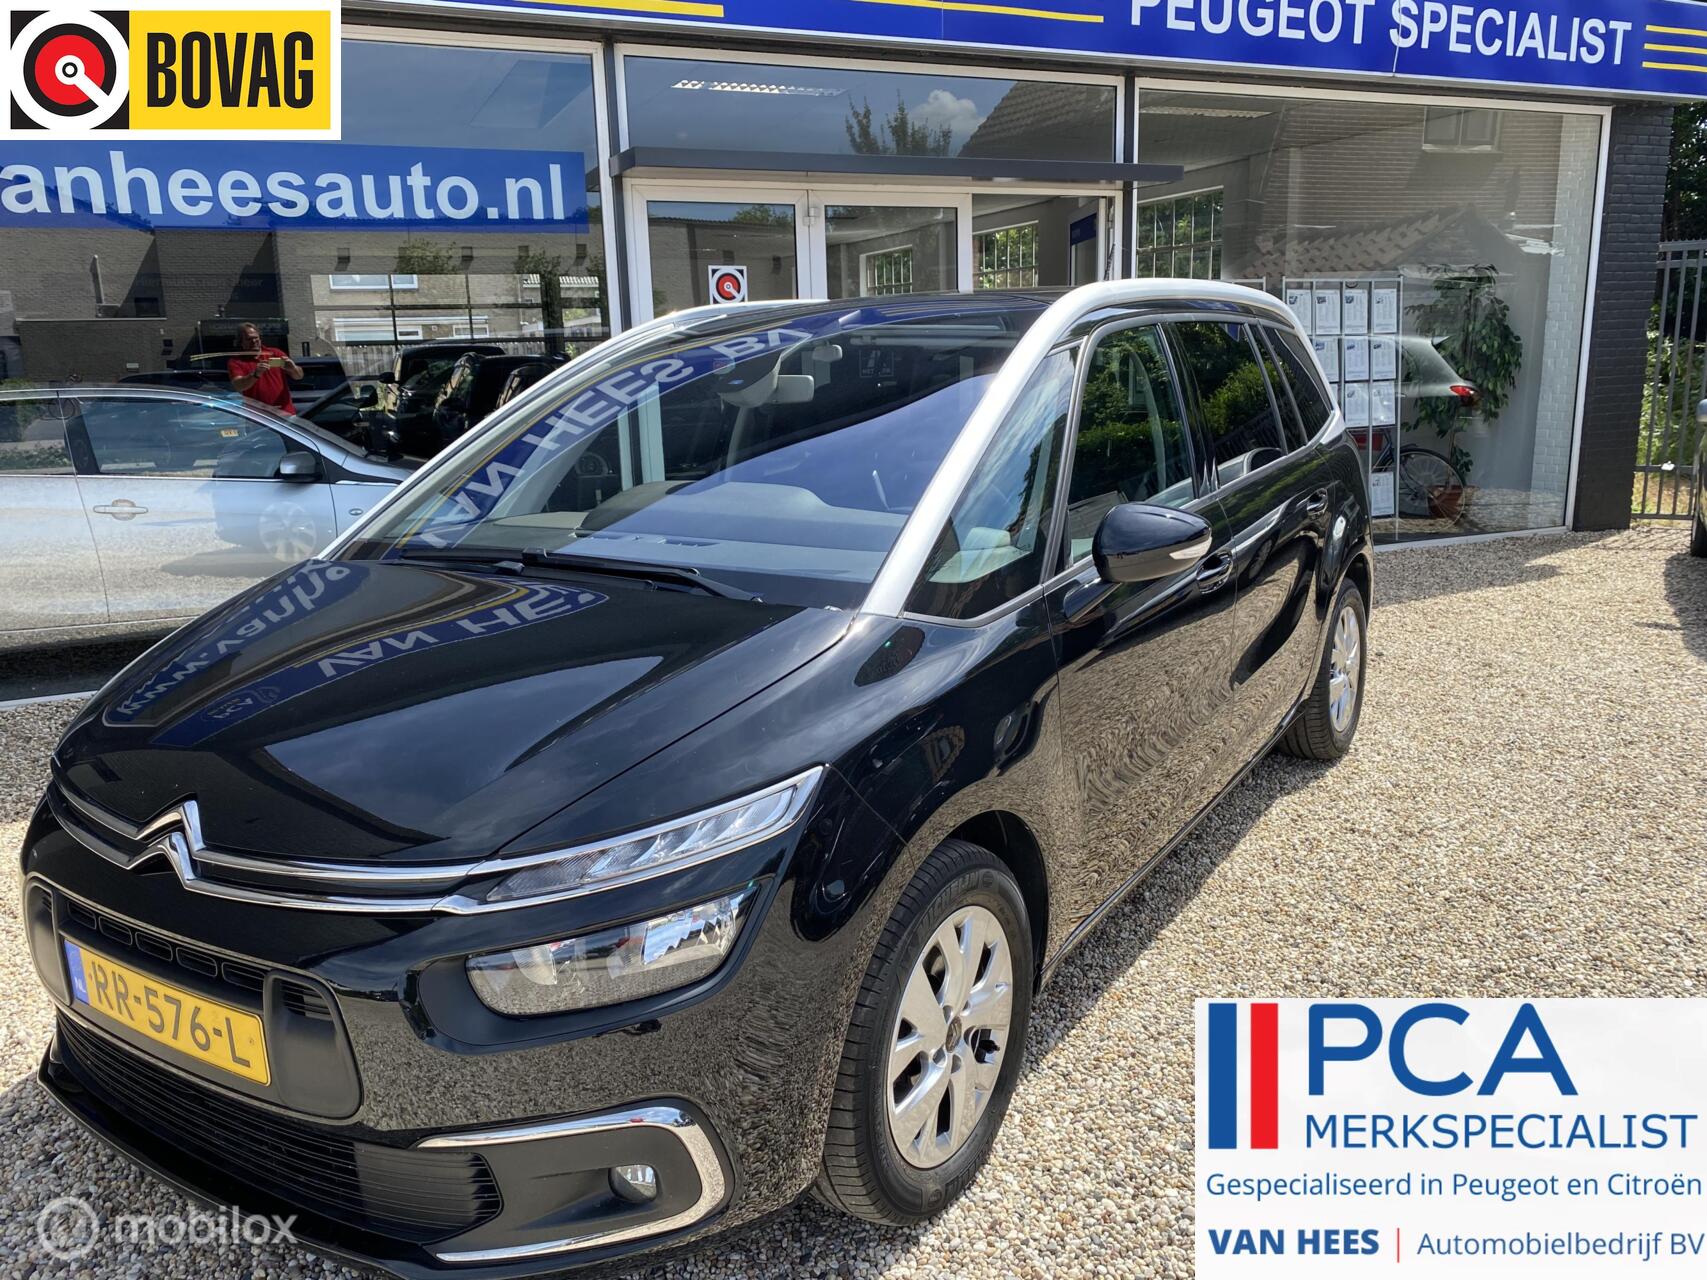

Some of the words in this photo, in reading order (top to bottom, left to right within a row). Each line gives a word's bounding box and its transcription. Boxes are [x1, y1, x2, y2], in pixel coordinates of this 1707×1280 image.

[1130, 0, 1376, 44] PEUGEOT
[1388, 0, 1632, 65] SPECIALIST
[0, 151, 564, 220] anheesauto.nl
[91, 961, 251, 1067] RR-576-L
